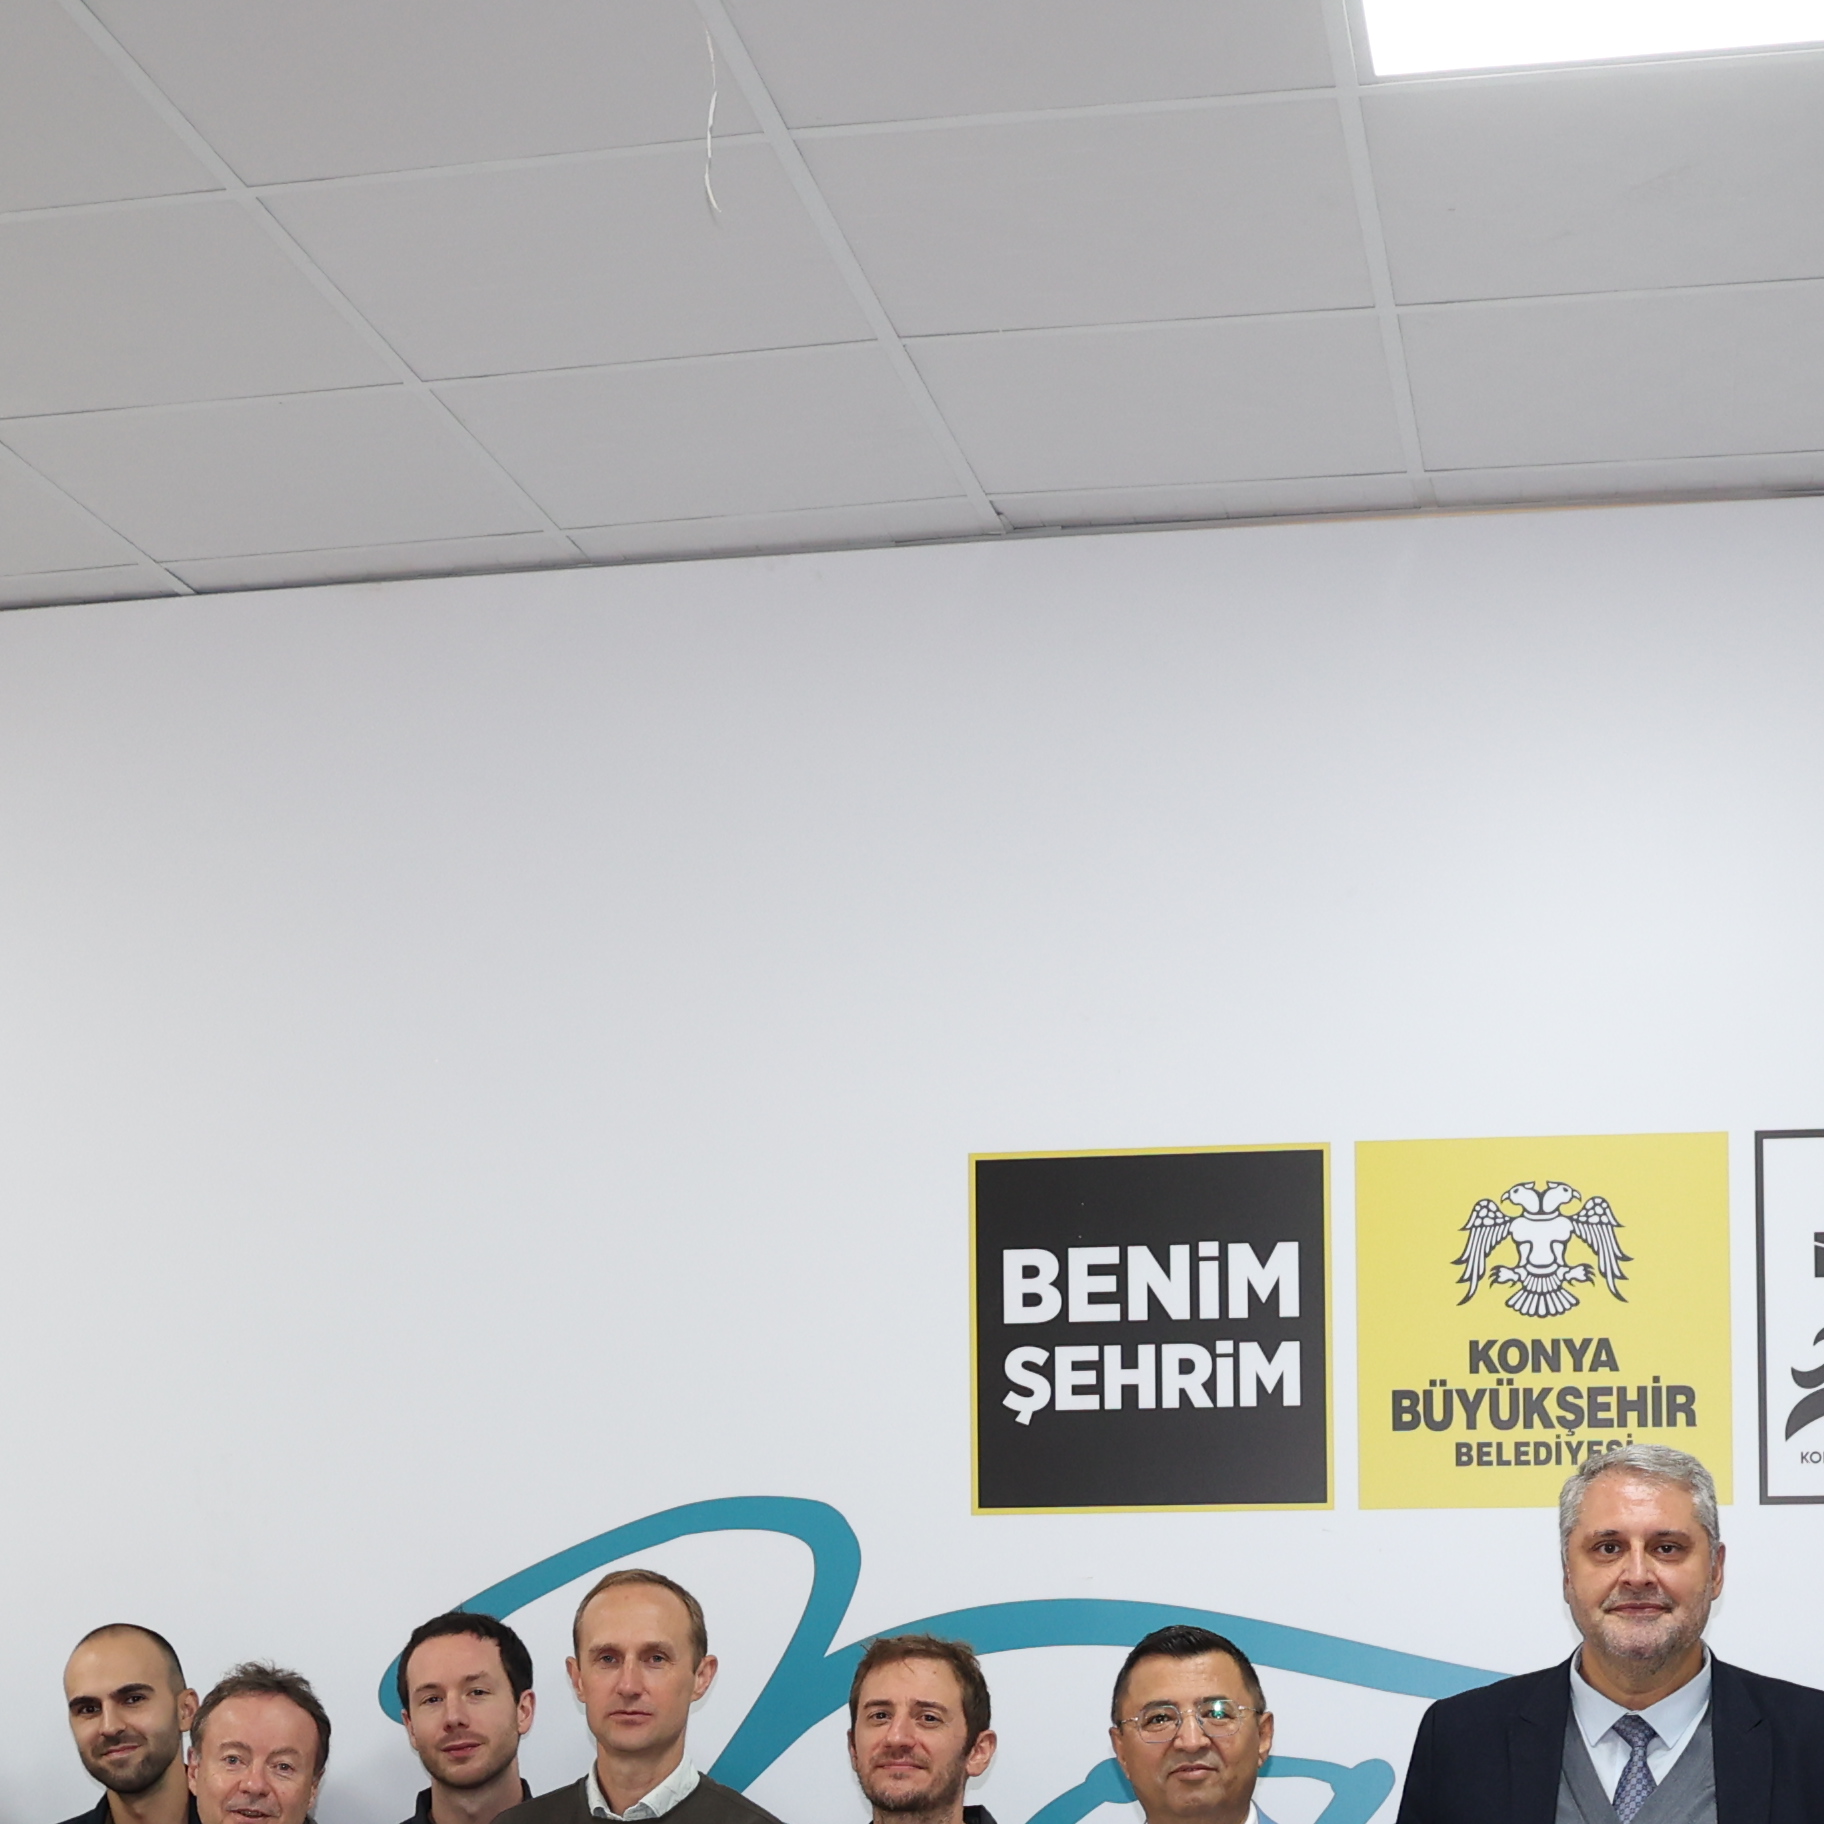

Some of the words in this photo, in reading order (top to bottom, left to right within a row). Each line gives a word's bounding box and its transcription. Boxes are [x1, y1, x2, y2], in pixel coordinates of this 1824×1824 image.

[1002, 1240, 1300, 1324] BENİM
[1002, 1339, 1301, 1426] ŞEHRİM
[1469, 1337, 1620, 1374] KONYA
[1391, 1375, 1698, 1436] BÜYÜKŞEHİR
